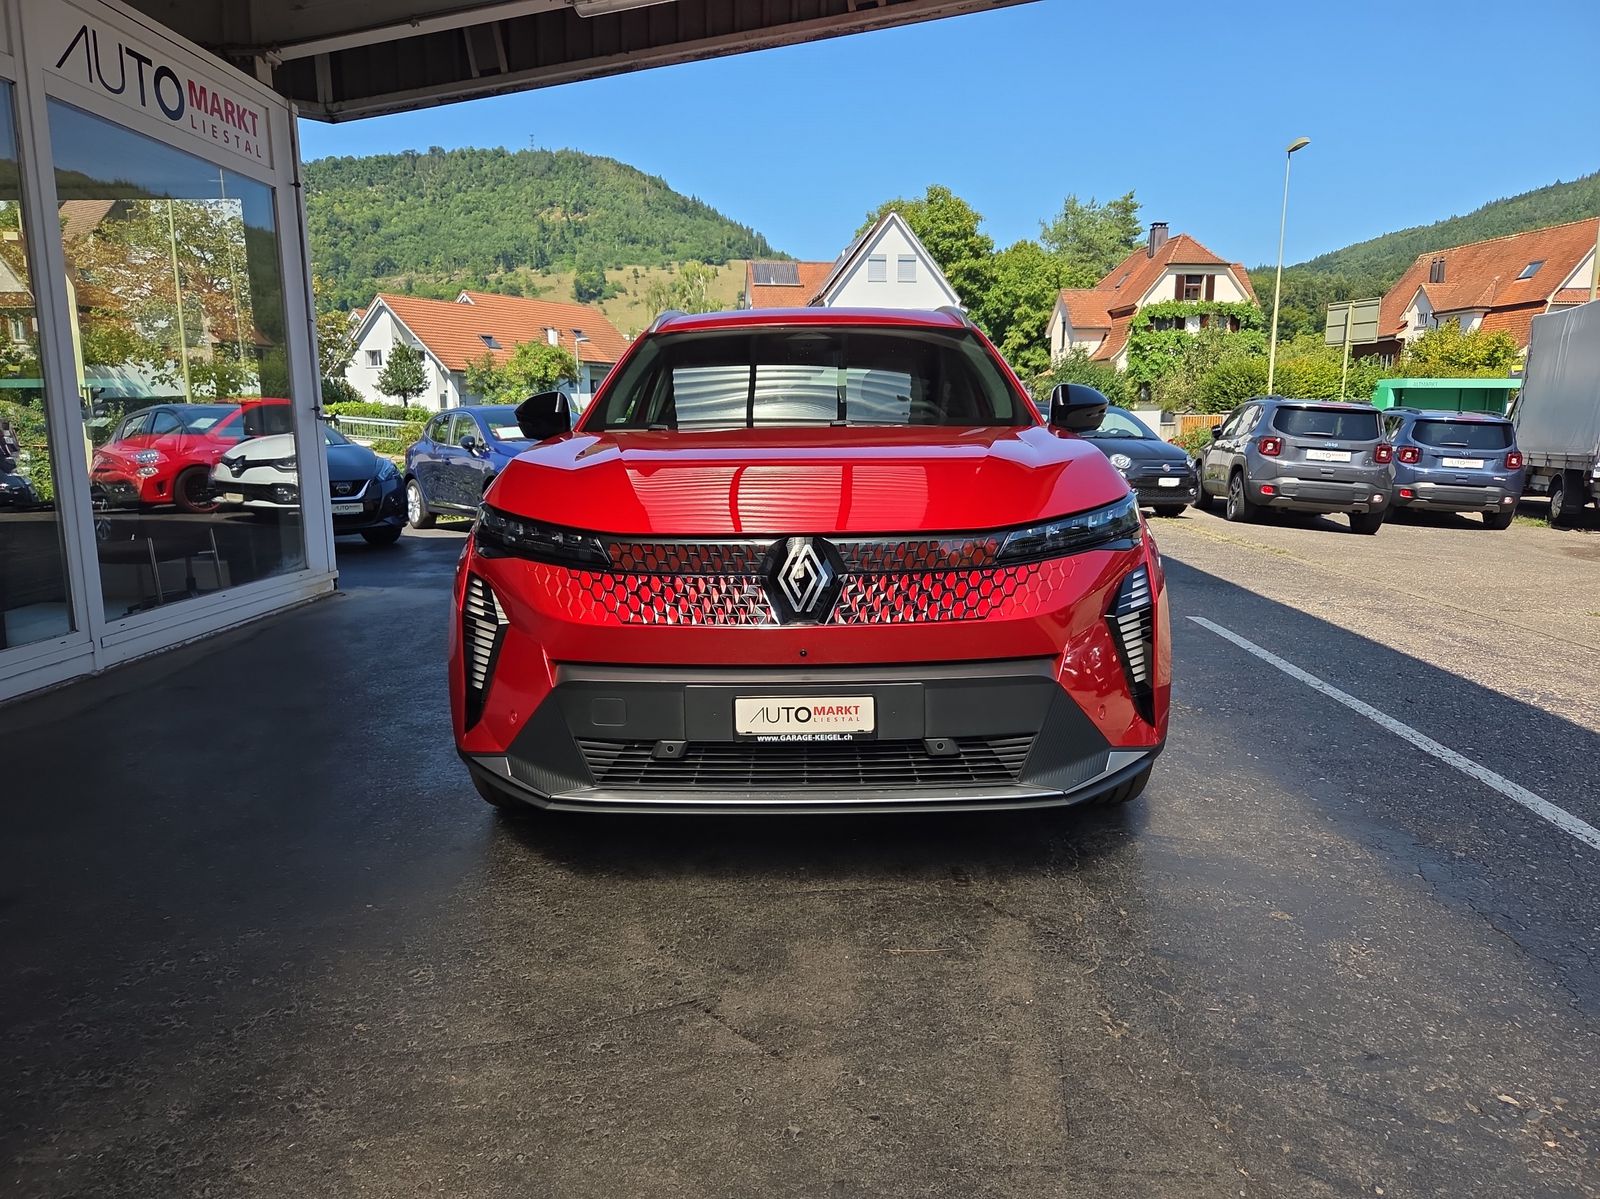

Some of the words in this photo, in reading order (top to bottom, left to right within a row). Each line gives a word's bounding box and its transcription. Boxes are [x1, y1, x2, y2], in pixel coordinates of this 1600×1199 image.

[187, 79, 258, 138] MARKT
[190, 114, 262, 159] LIESTAL
[750, 706, 812, 723] AUTO
[813, 705, 860, 716] MARKT
[757, 733, 853, 742] www.GARAGE-KEIGEL.ch
